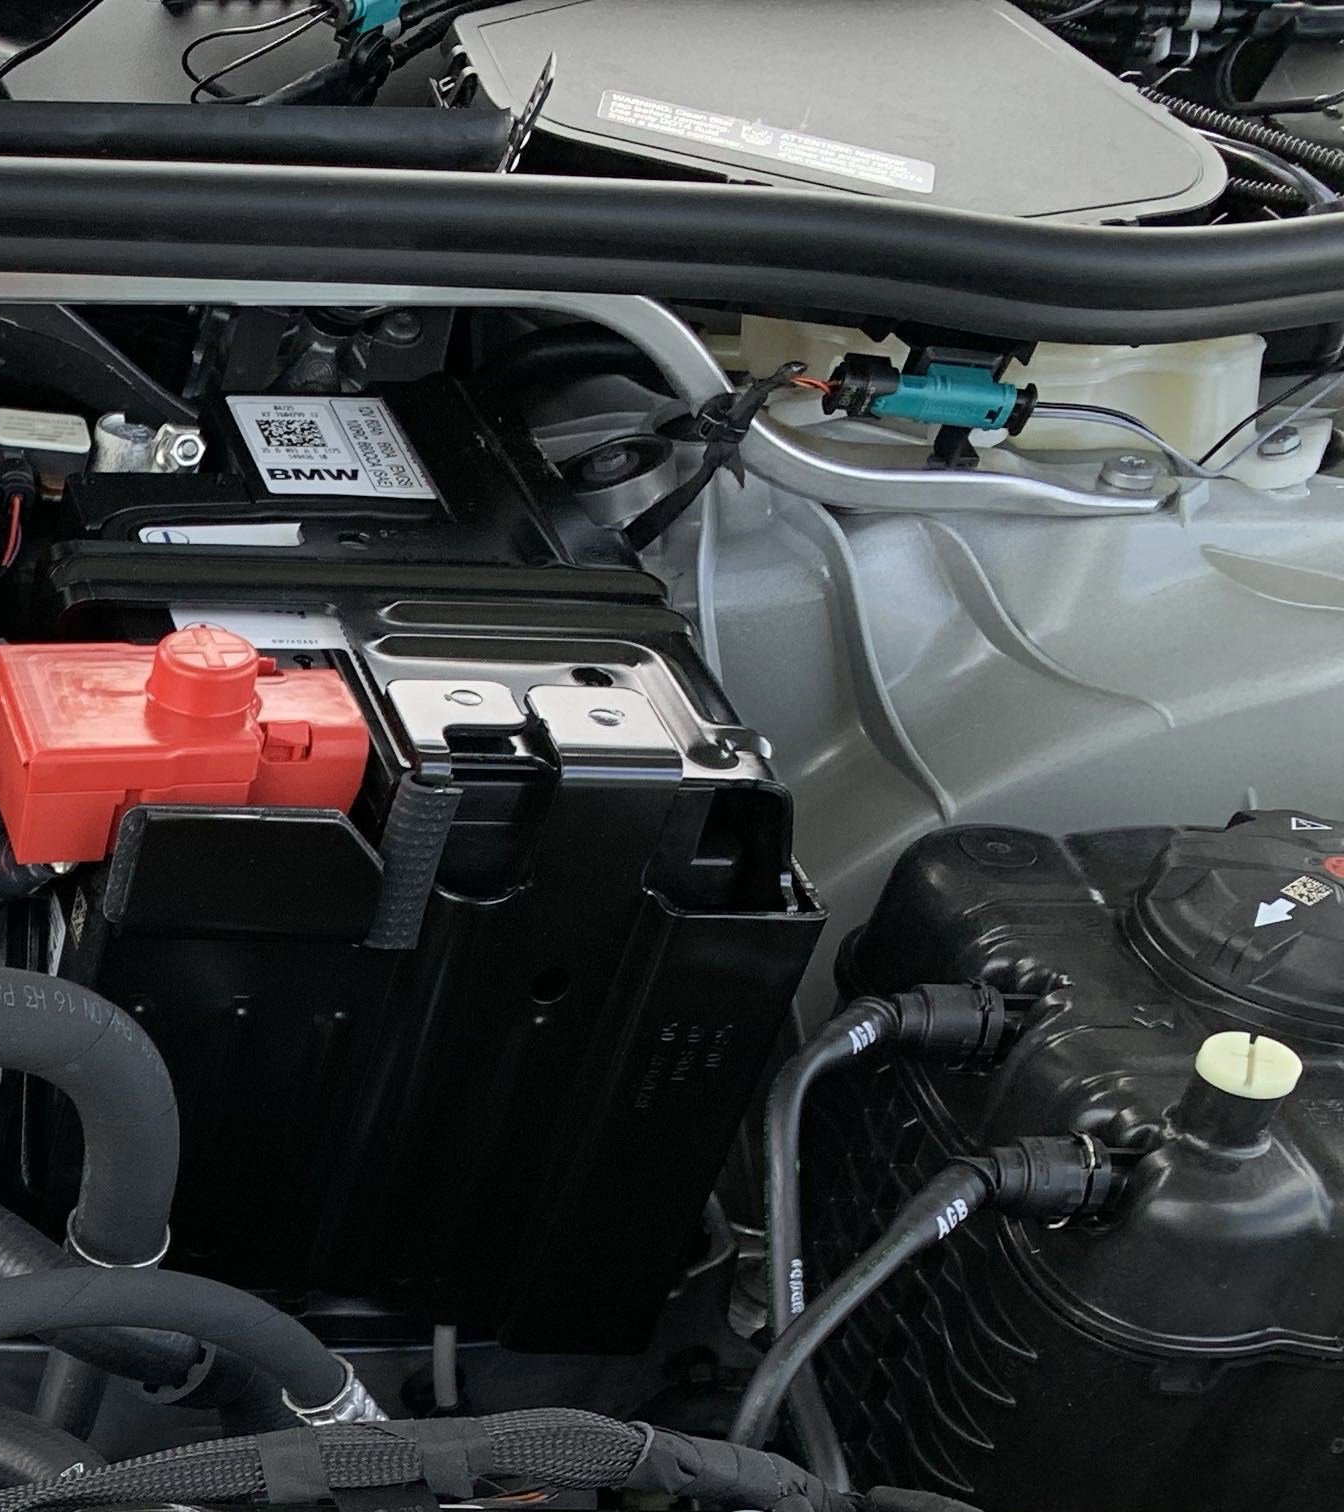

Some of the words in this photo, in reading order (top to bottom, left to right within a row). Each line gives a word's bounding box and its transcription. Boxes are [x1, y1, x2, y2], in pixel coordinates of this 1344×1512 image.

[613, 93, 673, 113] WARNING:
[266, 468, 359, 481] BMW
[848, 1020, 877, 1055] AGB
[936, 1198, 969, 1240] AGB
